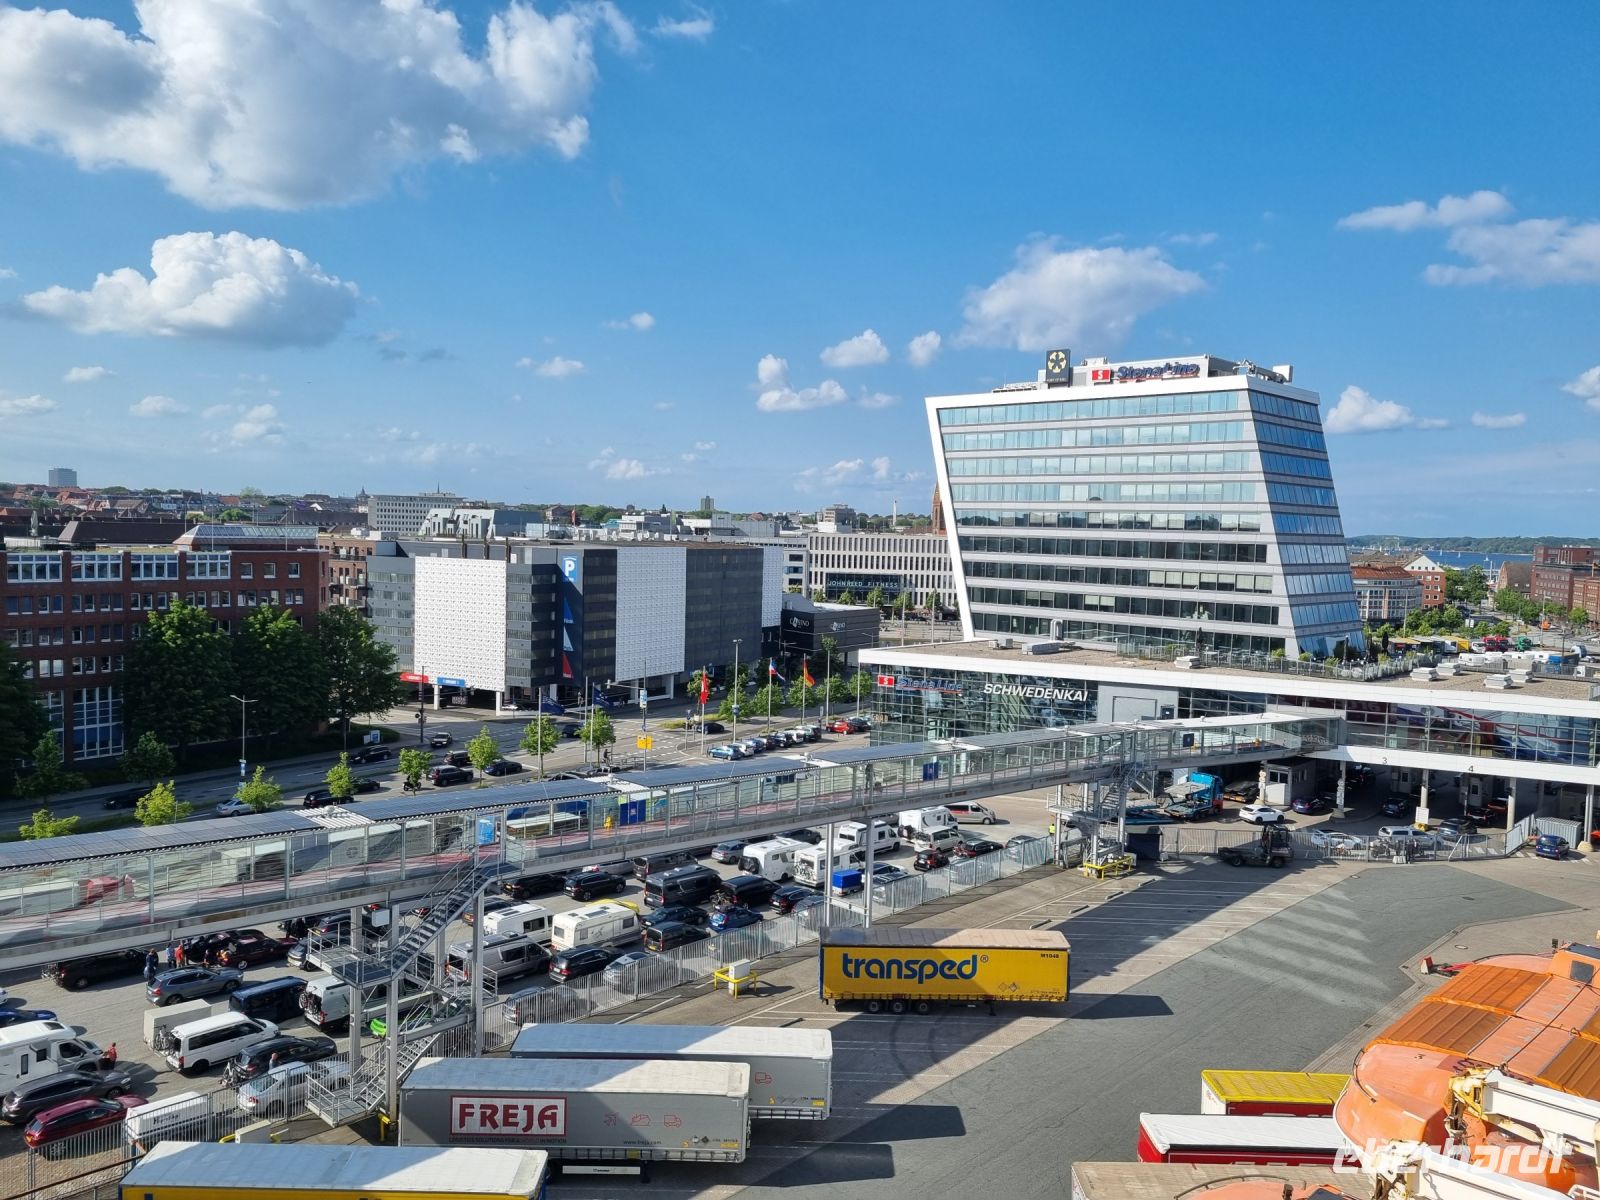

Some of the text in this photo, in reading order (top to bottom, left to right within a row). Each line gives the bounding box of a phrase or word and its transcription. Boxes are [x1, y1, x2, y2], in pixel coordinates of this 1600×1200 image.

[565, 560, 575, 576] P
[897, 675, 963, 692] Stena Line
[983, 683, 1089, 702] SCHWEDENKAI
[842, 953, 978, 984] transped
[458, 1103, 559, 1133] FREJA
